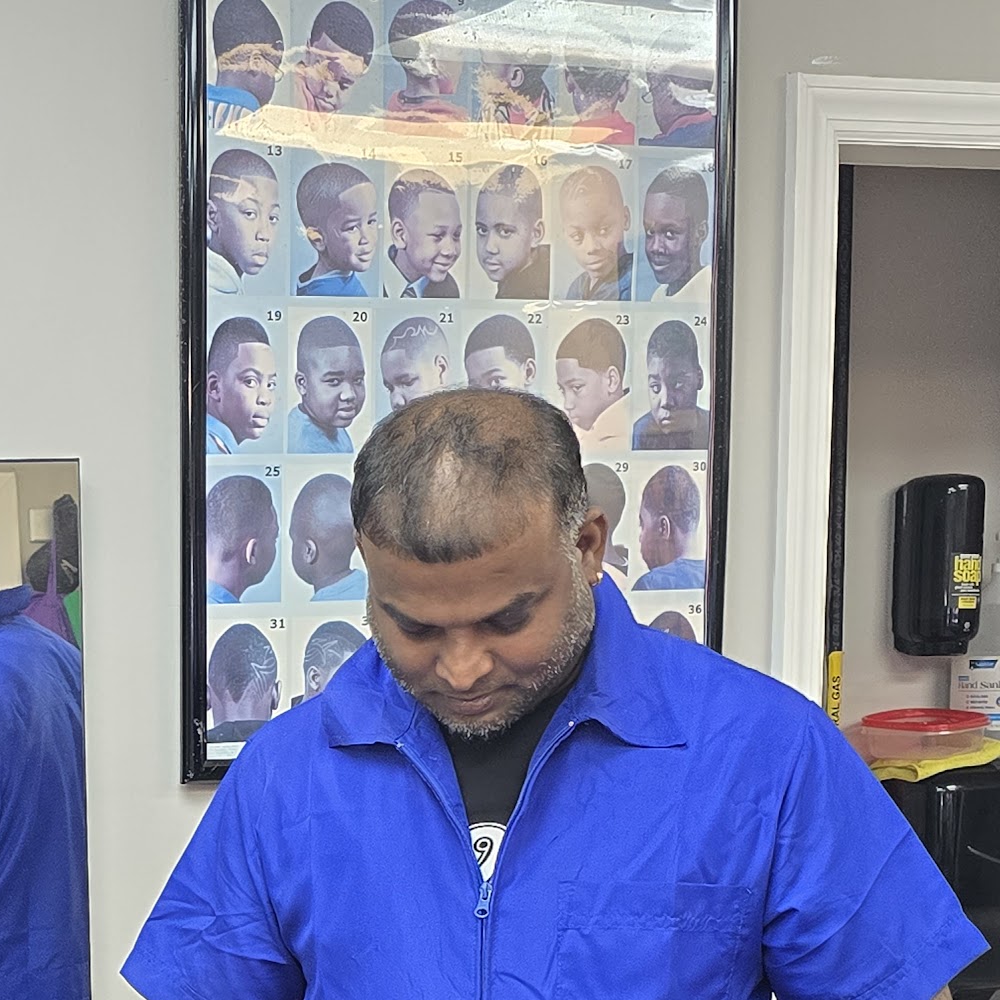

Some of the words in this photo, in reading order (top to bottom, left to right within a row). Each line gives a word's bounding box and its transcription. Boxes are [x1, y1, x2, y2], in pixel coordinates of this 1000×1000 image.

[267, 145, 282, 156] 13
[361, 148, 376, 160] 14
[448, 152, 463, 163] 15
[533, 155, 548, 167] 16
[618, 159, 633, 170] 17
[266, 310, 282, 321] 19
[352, 311, 368, 322] 20
[439, 312, 454, 323] 21
[527, 313, 543, 324] 22
[616, 314, 630, 325] 23
[694, 316, 707, 326] 24
[264, 466, 280, 477] 25
[615, 462, 629, 472] 29
[692, 462, 706, 472] 30
[688, 604, 702, 615] 36
[269, 618, 285, 629] 31
[831, 675, 841, 700] GAS
[958, 680, 978, 689] Hand
[473, 836, 494, 868] 9
